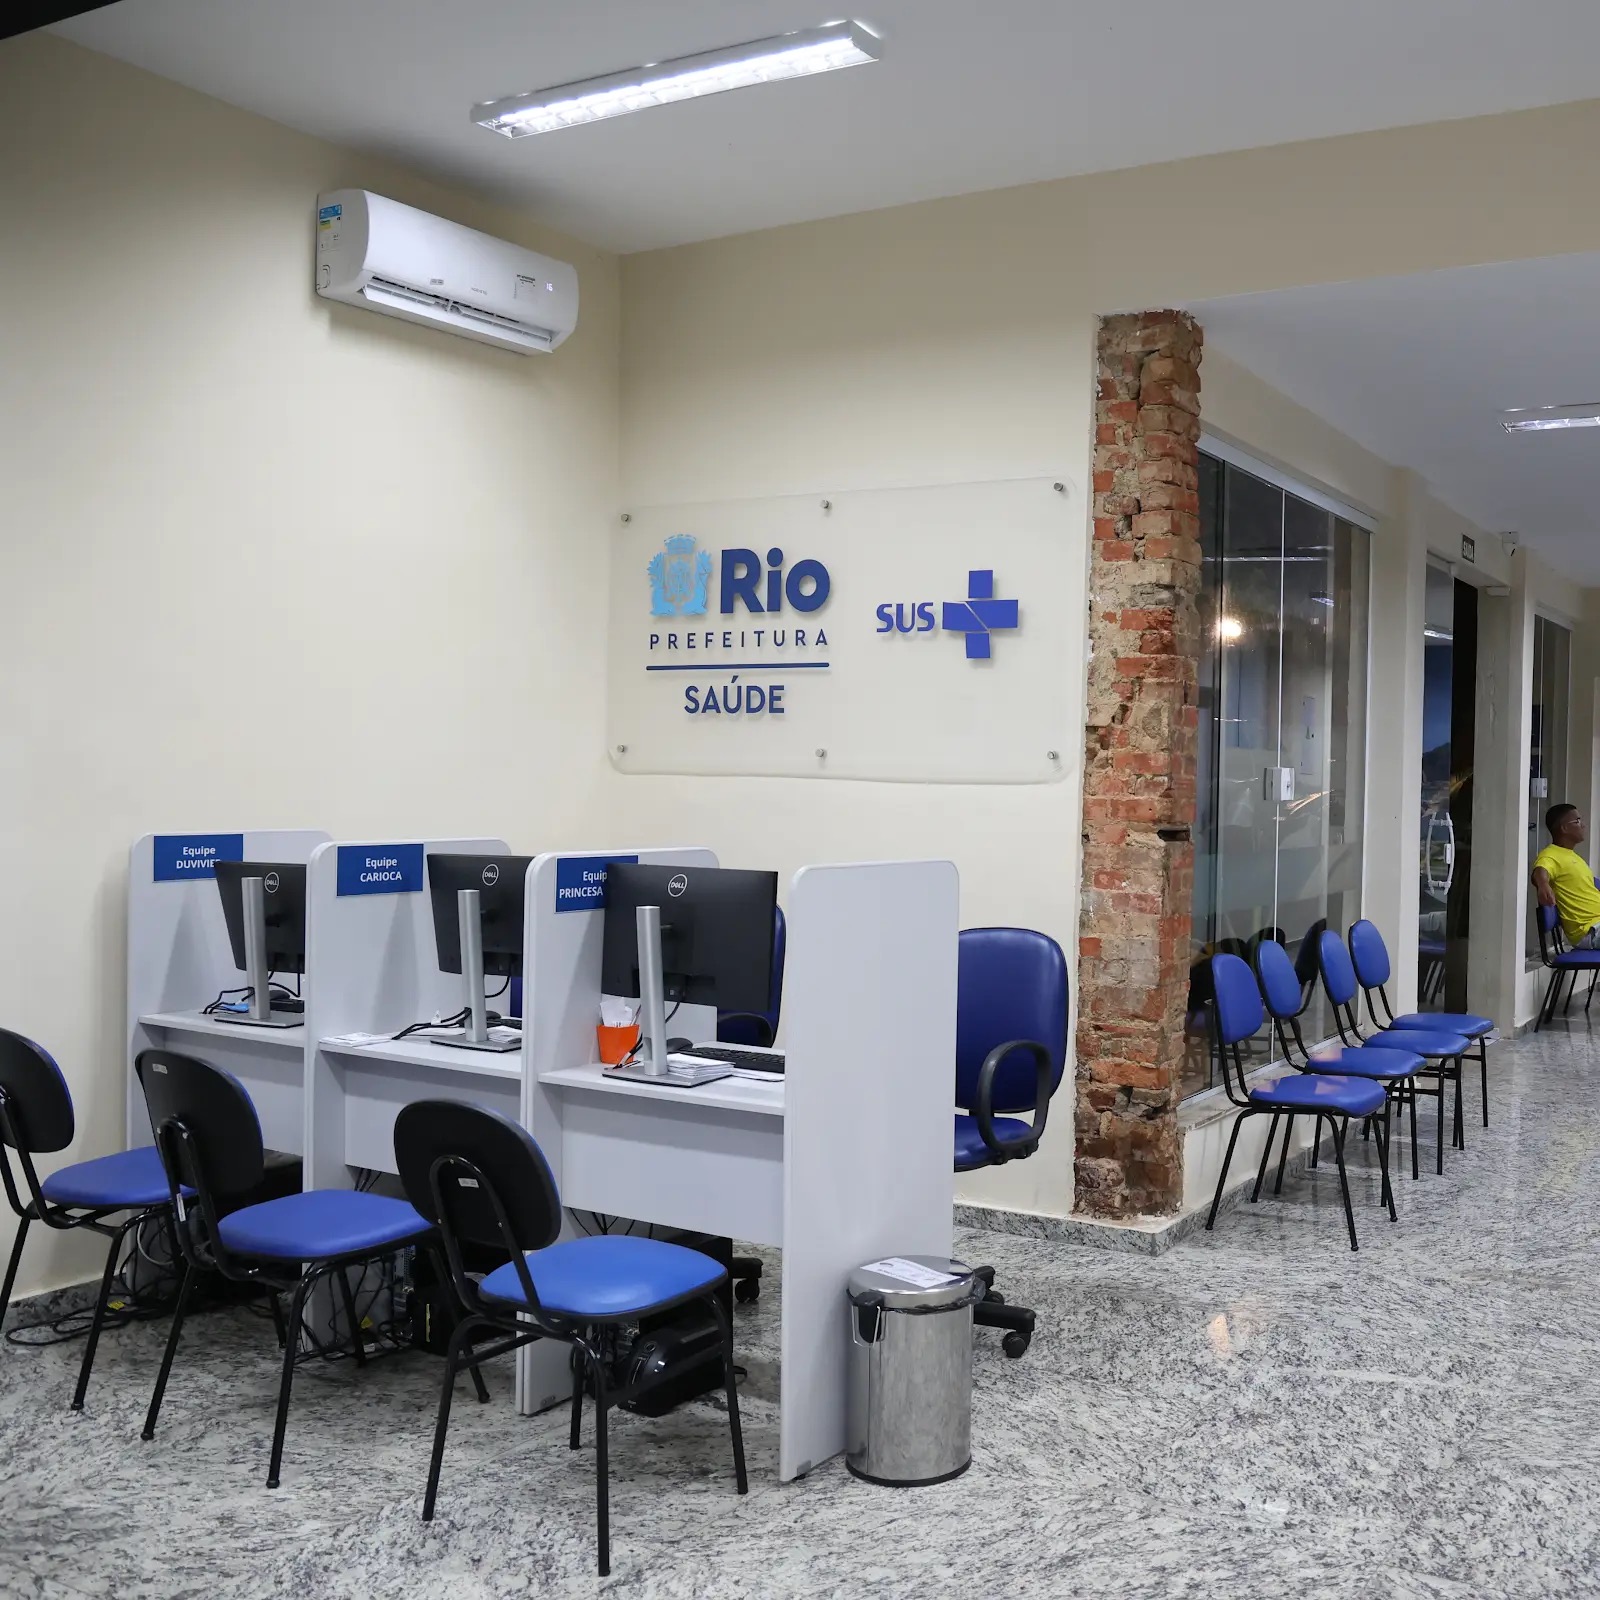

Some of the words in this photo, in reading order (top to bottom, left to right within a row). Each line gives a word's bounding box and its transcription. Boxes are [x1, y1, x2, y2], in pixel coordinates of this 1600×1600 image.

[720, 547, 831, 614] Rio
[876, 602, 936, 633] SUS
[650, 628, 828, 650] PREFEITURA
[684, 675, 785, 714] SAÚDE
[183, 846, 216, 857] Equipe
[176, 859, 221, 869] DUVIVIE
[365, 857, 398, 869] Equipe
[360, 871, 402, 882] CARIOCA
[582, 870, 608, 883] Equip
[670, 881, 685, 889] DELL
[559, 886, 603, 899] PRINCESA
